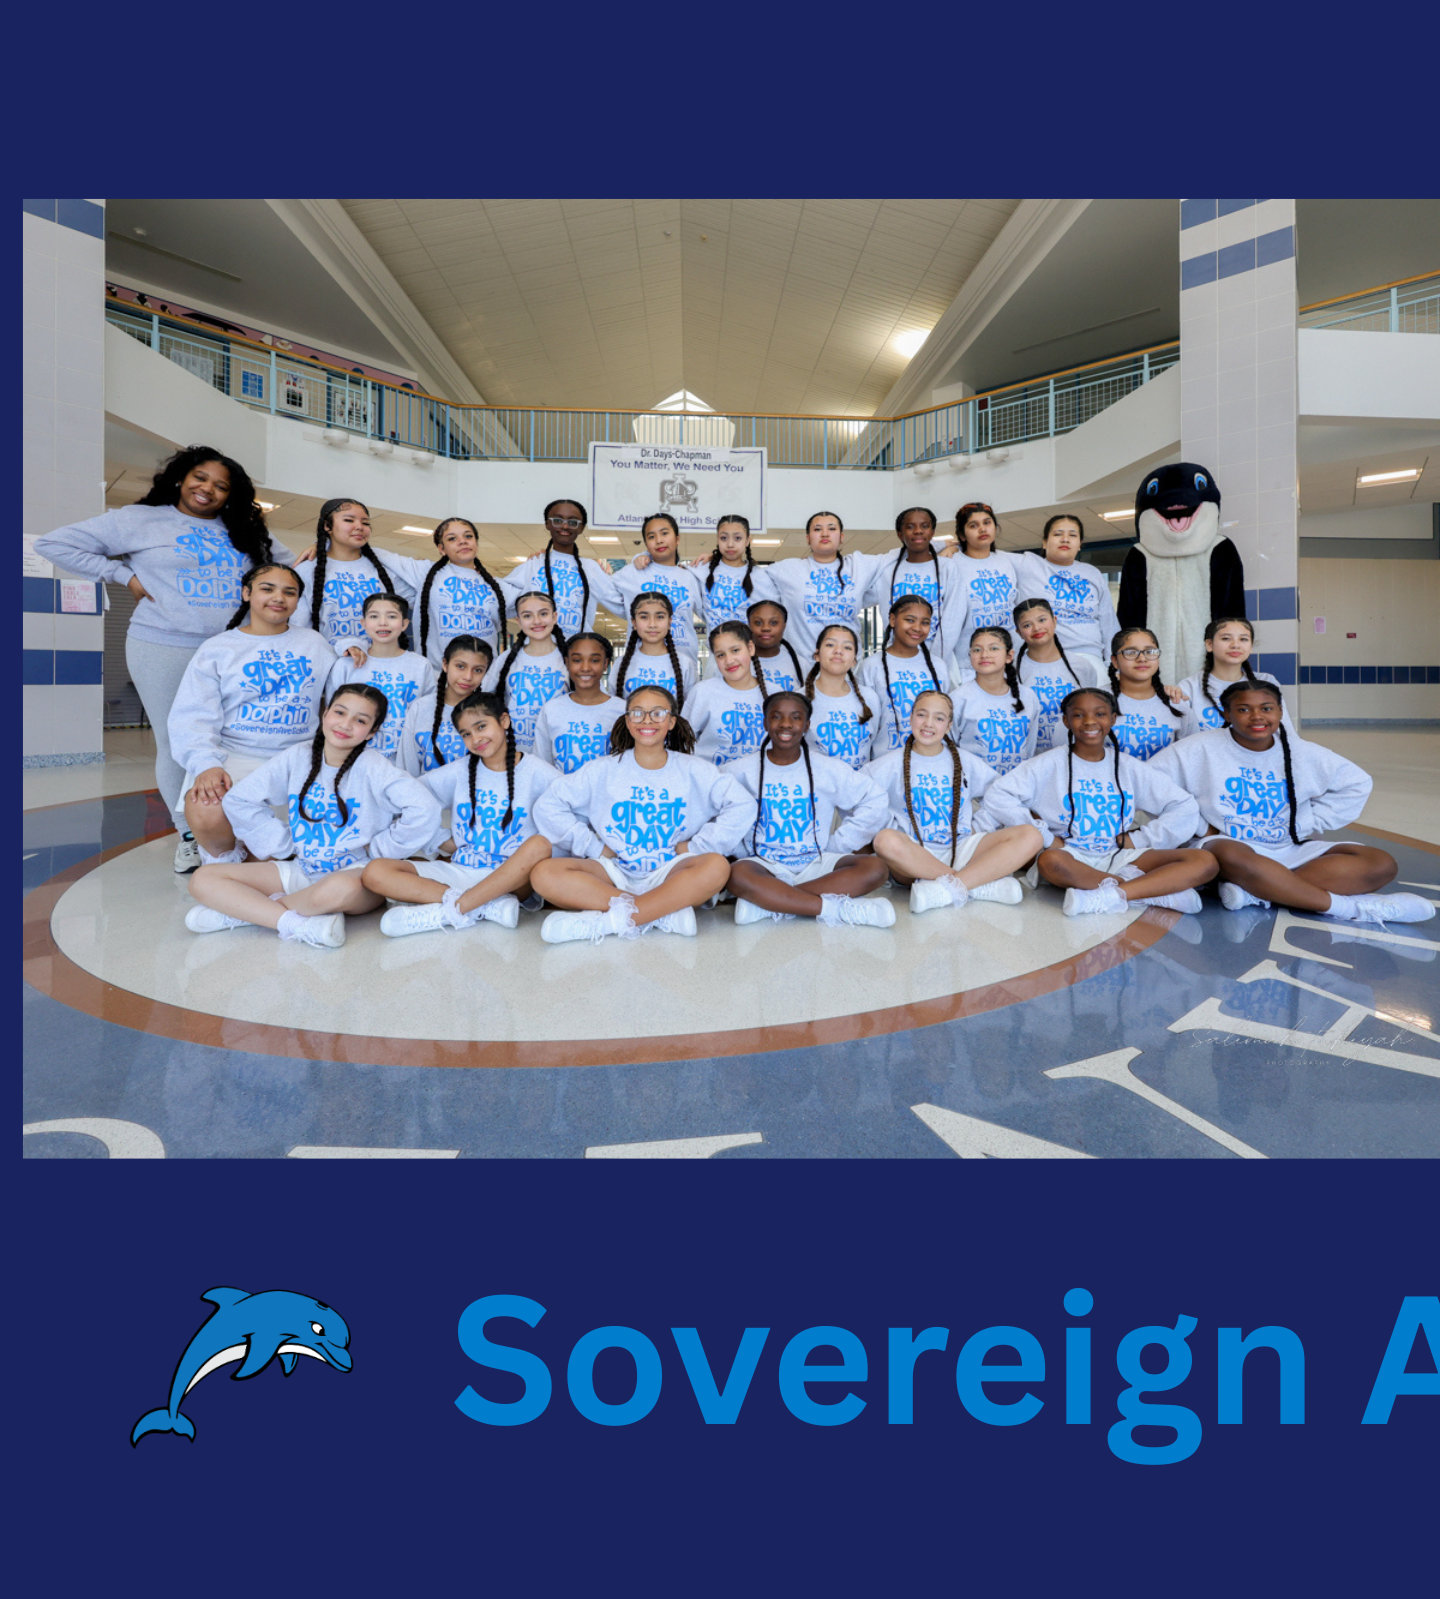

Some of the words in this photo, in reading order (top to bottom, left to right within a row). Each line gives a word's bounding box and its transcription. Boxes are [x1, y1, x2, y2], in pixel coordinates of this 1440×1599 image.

[641, 449, 651, 458] Dr.
[653, 449, 712, 461] Days-Chapman
[610, 460, 631, 469] You
[634, 461, 671, 471] Matter,
[673, 462, 690, 471] We
[693, 463, 720, 472] Need
[724, 464, 744, 473] You
[618, 514, 648, 523] Atlan
[680, 516, 702, 525] High
[553, 559, 569, 568] It's
[198, 567, 210, 577] to
[218, 567, 233, 578] be
[335, 572, 353, 580] It's
[654, 574, 667, 584] It's
[719, 573, 732, 582] It's
[904, 573, 921, 582] It's
[977, 569, 991, 577] It's
[324, 577, 381, 597] great
[641, 582, 689, 600] great
[893, 582, 943, 600] great
[970, 574, 1012, 596] great
[1049, 574, 1091, 594] great
[452, 589, 488, 606] DAY
[982, 588, 1010, 605] DAY
[1056, 588, 1088, 604] DAY
[464, 605, 475, 613] be
[711, 596, 743, 612] DAY
[1065, 602, 1076, 610] be
[339, 609, 349, 617] to
[258, 650, 281, 661] It's
[285, 651, 294, 659] a
[242, 656, 313, 687] great
[371, 671, 391, 681] It's
[395, 673, 404, 681] a
[523, 665, 542, 673] It's
[638, 668, 656, 677] It's
[659, 670, 666, 678] a
[896, 671, 915, 680] It's
[920, 671, 927, 679] a
[260, 675, 306, 696] DAY
[509, 670, 565, 693] great
[1035, 677, 1052, 686] It's
[1056, 677, 1063, 685] a
[258, 694, 270, 703] to
[275, 694, 288, 703] be
[292, 695, 300, 703] a
[516, 688, 556, 706] DAY
[237, 701, 310, 725] Dolphin
[734, 702, 752, 711] It's
[755, 703, 762, 711] a
[987, 708, 1008, 718] It's
[828, 710, 847, 721] It's
[850, 712, 857, 720] a
[1125, 713, 1145, 725] It's
[1148, 716, 1157, 725] a
[568, 721, 590, 733] It's
[593, 723, 602, 733] a
[817, 721, 870, 746] great
[978, 715, 1031, 741] great
[732, 727, 768, 746] DAY
[988, 734, 1025, 753] DAY
[828, 738, 861, 757] DAY
[917, 773, 938, 786] It's
[941, 775, 950, 785] a
[1239, 767, 1262, 780] It's
[1266, 771, 1275, 781] a
[765, 783, 789, 797] It's
[793, 784, 802, 796] a
[1078, 779, 1103, 792] It's
[1106, 781, 1115, 792] a
[630, 786, 655, 801] It's
[659, 789, 669, 800] a
[1063, 791, 1133, 822] great
[1236, 795, 1286, 819] DAY
[611, 797, 687, 834] great
[1253, 818, 1265, 827] be
[765, 819, 810, 843] DAY
[1080, 814, 1121, 837] DAY
[292, 820, 346, 847] DAY
[625, 824, 676, 850] DAY
[464, 829, 506, 855] DAY
[303, 846, 319, 858] be
[324, 848, 335, 857] a
